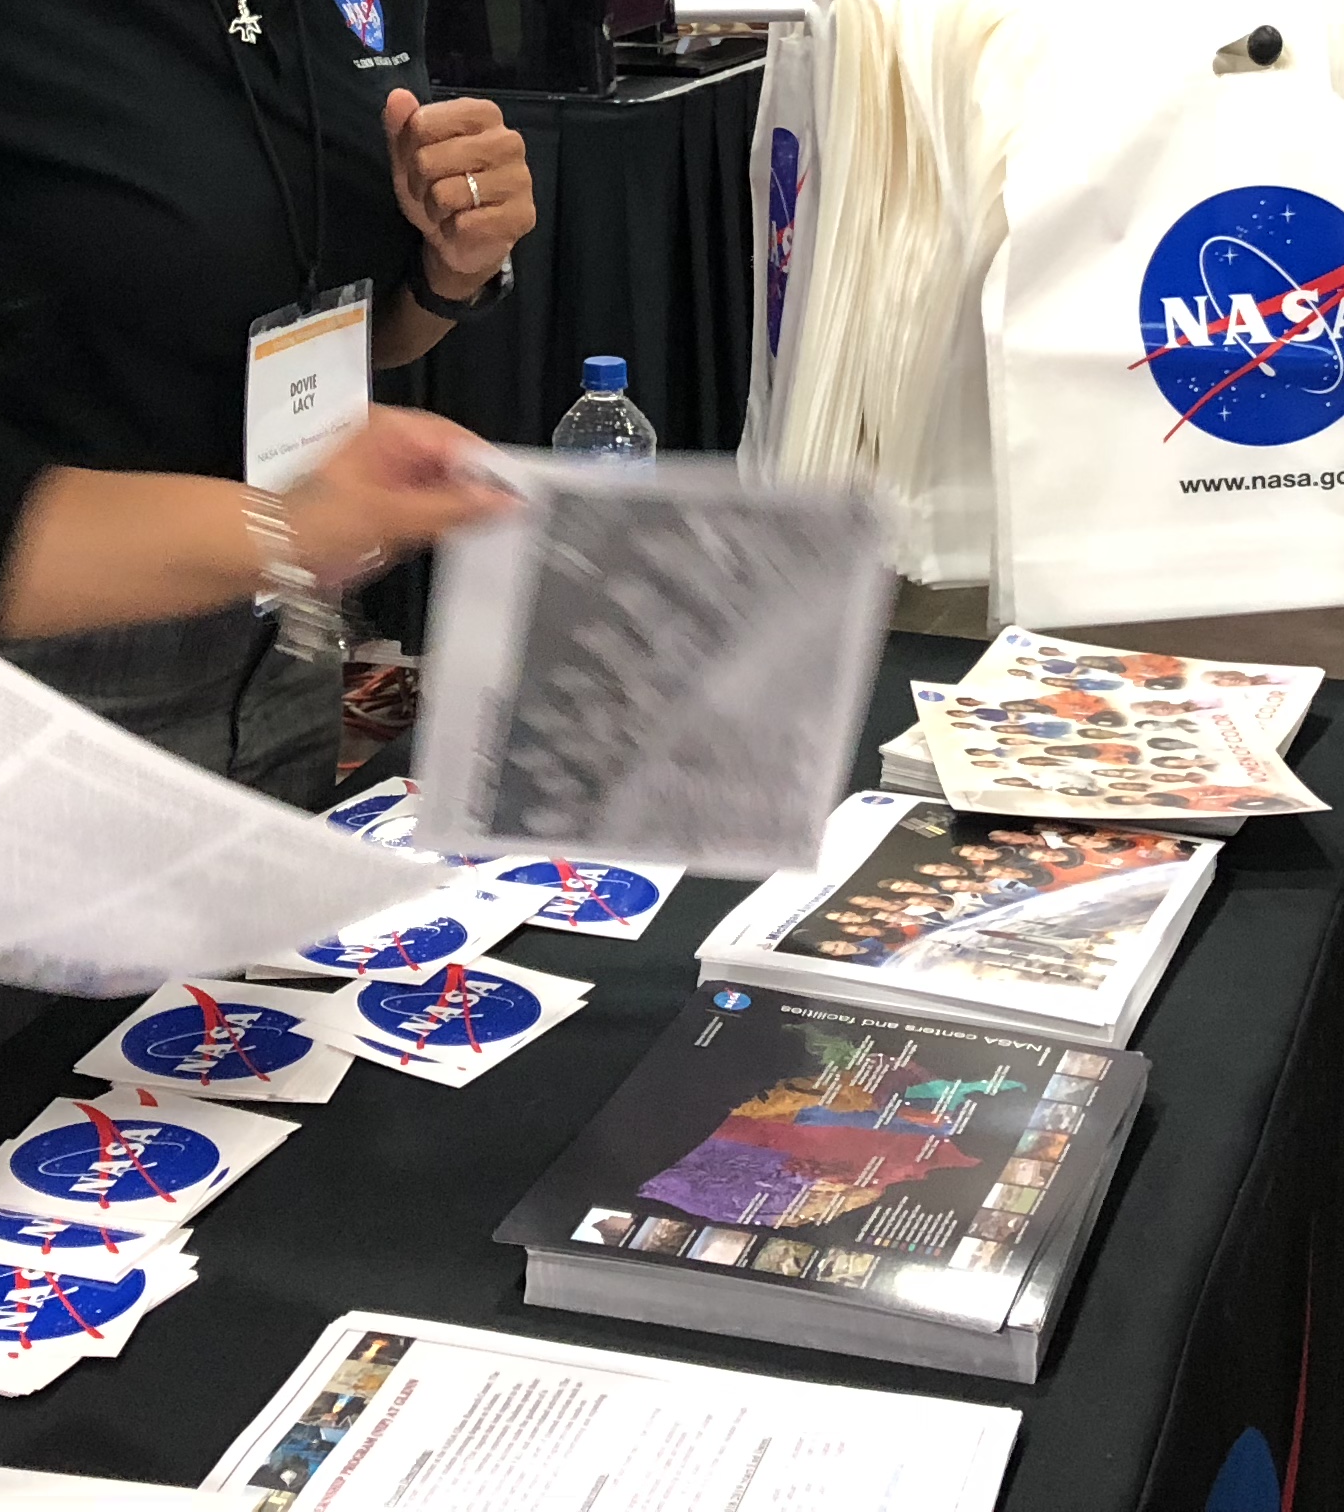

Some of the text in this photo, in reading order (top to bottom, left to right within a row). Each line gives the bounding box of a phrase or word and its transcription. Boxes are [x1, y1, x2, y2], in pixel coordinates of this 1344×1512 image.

[290, 373, 318, 398] DOVIE
[293, 393, 316, 414] LACY
[544, 868, 609, 916] NASA
[398, 980, 504, 1039] NASA
[780, 1005, 1042, 1053] NASA centers and facilities
[173, 1011, 263, 1074] NASA
[69, 1127, 163, 1195] NASA
